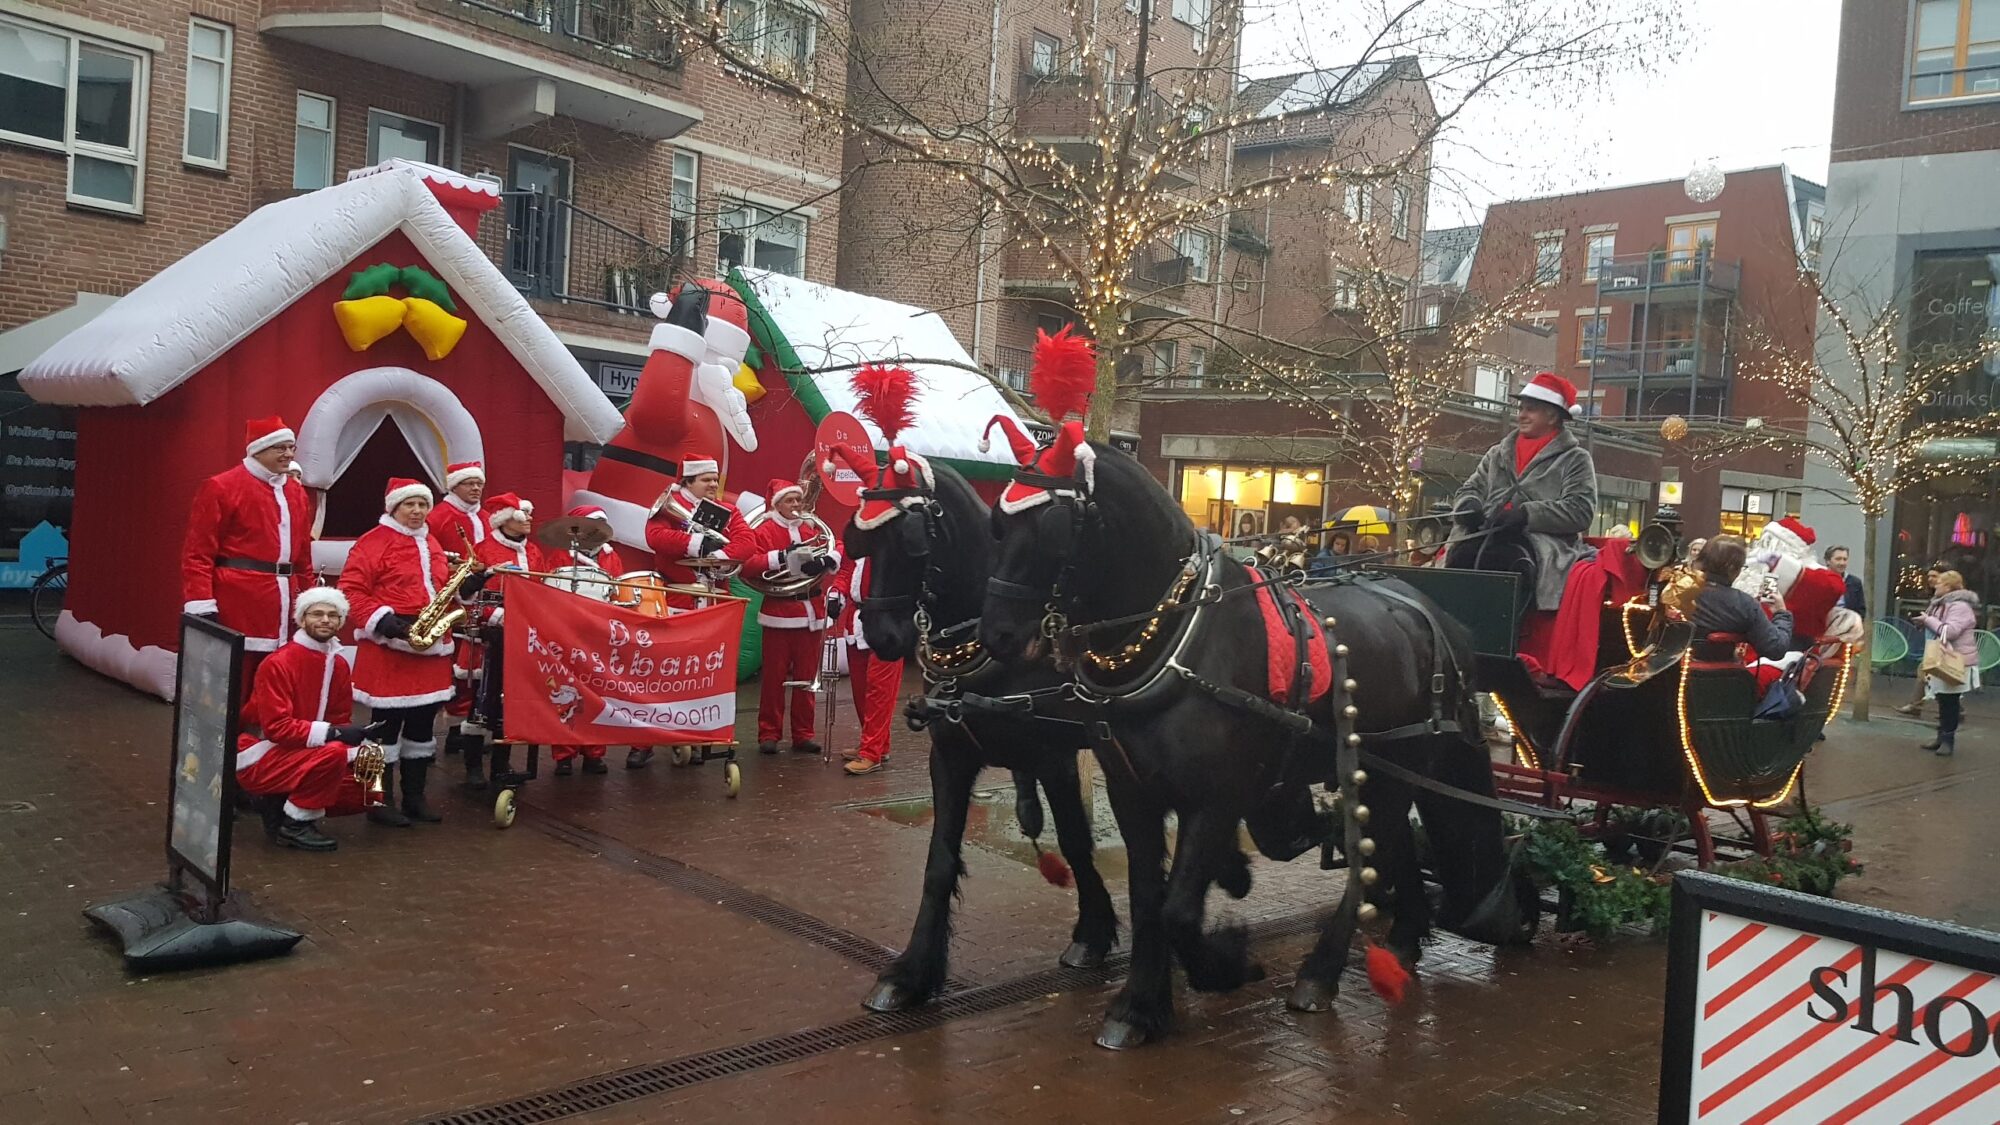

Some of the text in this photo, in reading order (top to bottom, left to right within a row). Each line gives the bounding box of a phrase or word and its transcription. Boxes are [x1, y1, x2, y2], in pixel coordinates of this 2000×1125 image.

[836, 430, 849, 440] De
[818, 442, 869, 454] Keand
[6, 455, 22, 465] De
[836, 471, 858, 480] Apeld
[609, 618, 654, 647] De
[1807, 944, 2000, 1057] sho
